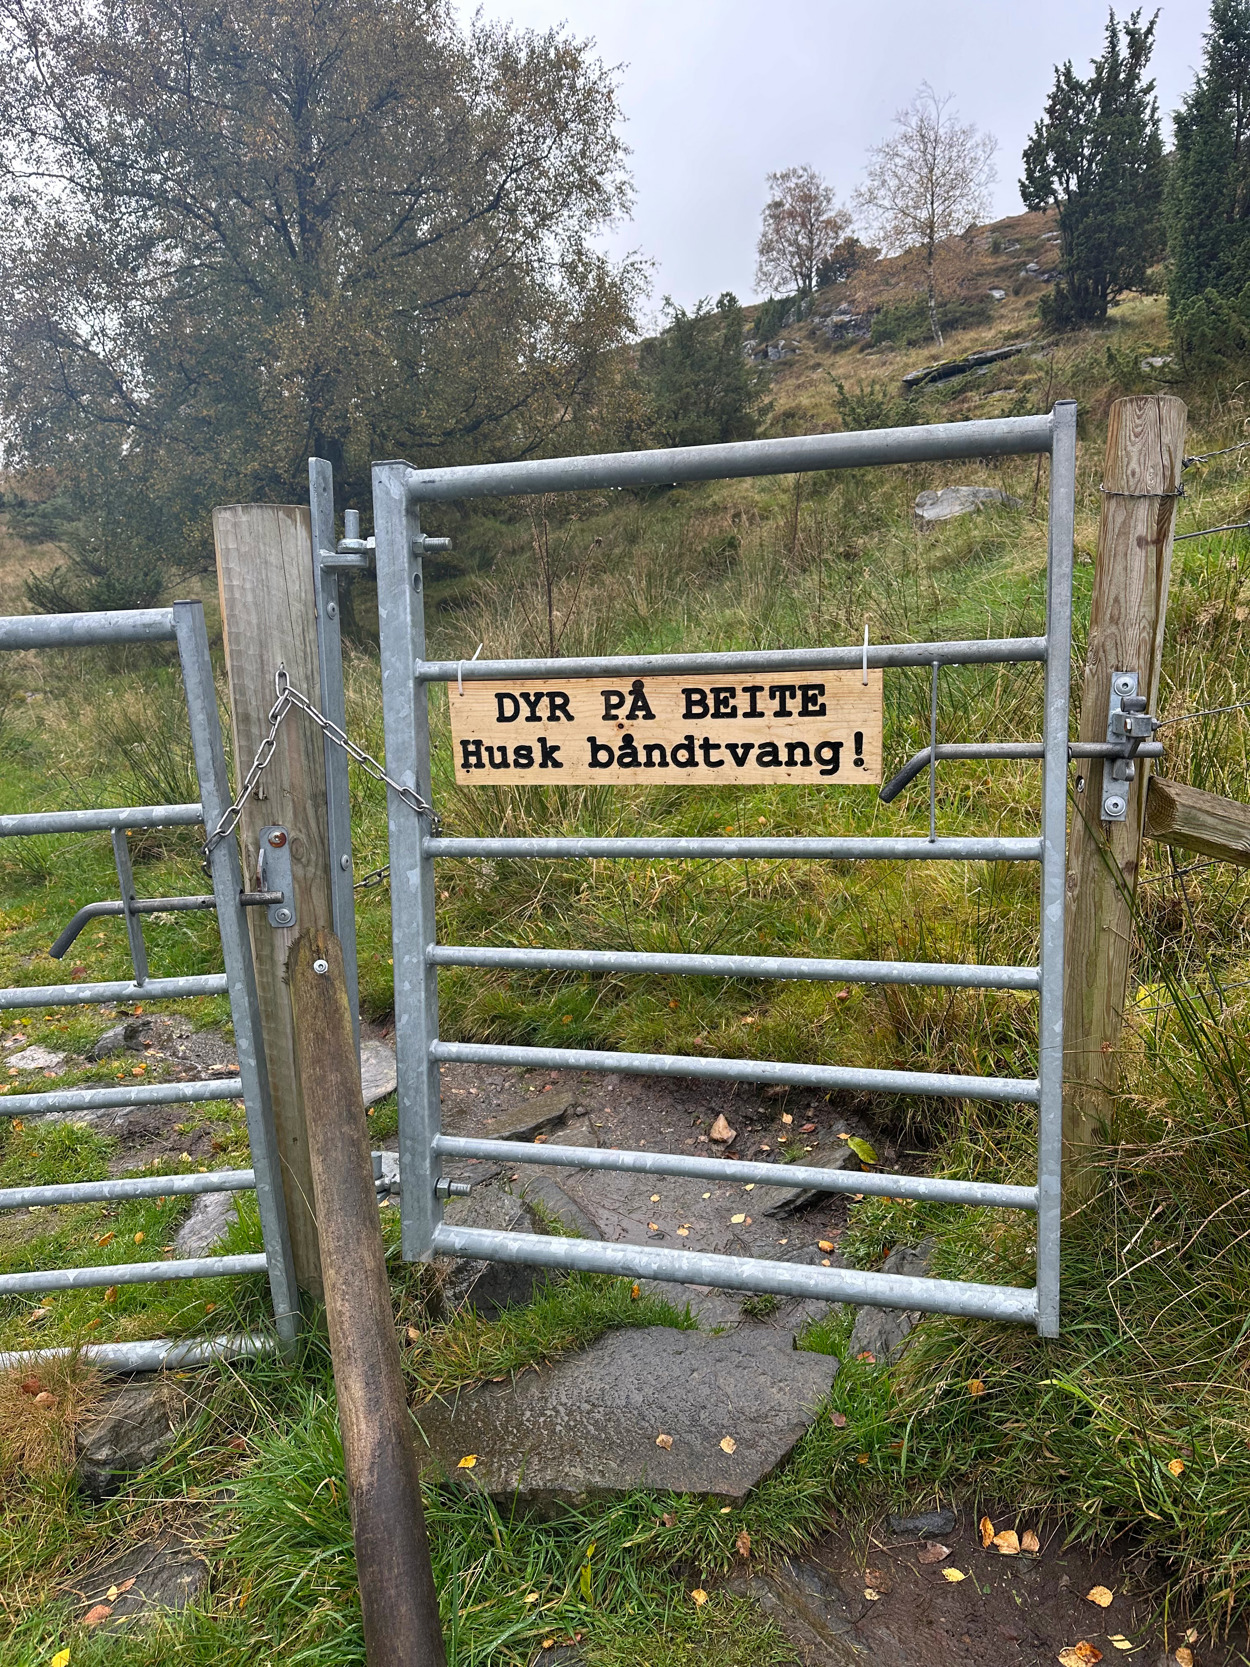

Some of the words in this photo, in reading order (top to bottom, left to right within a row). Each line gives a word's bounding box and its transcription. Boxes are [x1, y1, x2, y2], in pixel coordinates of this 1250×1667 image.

[494, 691, 575, 723] DYR
[600, 679, 657, 721] PÅ
[681, 683, 828, 720] BEITE
[459, 736, 564, 770] Husk
[586, 730, 866, 776] båndtvang!
